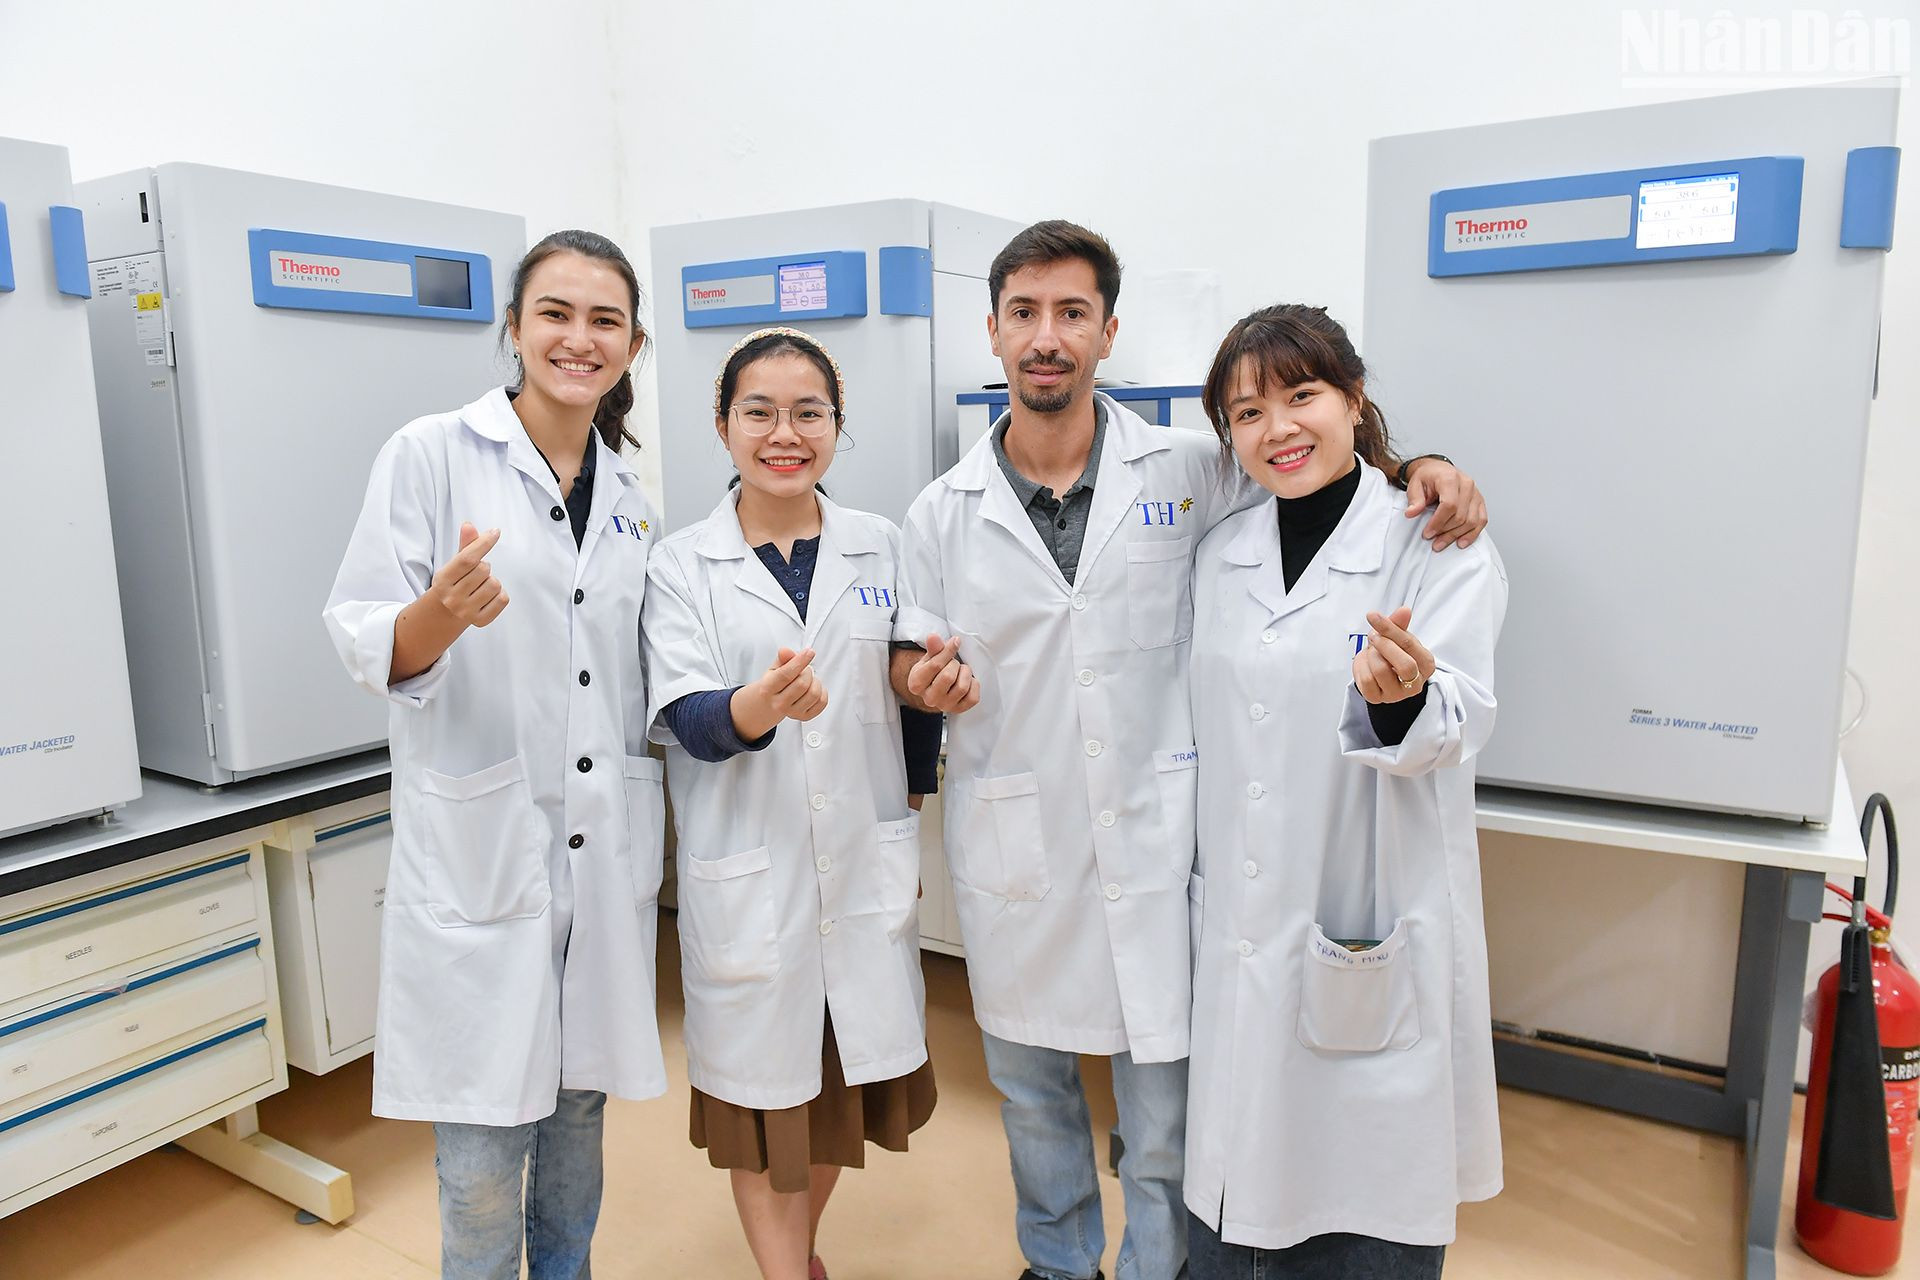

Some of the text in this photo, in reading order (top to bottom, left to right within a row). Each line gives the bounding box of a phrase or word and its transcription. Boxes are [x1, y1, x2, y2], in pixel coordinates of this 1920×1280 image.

[1455, 218, 1528, 235] Thermo
[1458, 232, 1526, 243] SCIENTIFIC
[278, 258, 340, 277] Thermo
[282, 274, 341, 284] SCIENTIFIC
[691, 288, 726, 299] Thermo
[1136, 501, 1175, 526] TH
[610, 514, 643, 541] TH
[853, 586, 893, 607] TH
[1629, 714, 1758, 735] SERIES 3 WATER JACKETED
[29, 735, 75, 751] JACKETED
[199, 902, 221, 915] GLOVES
[65, 945, 94, 961] NEEDLES
